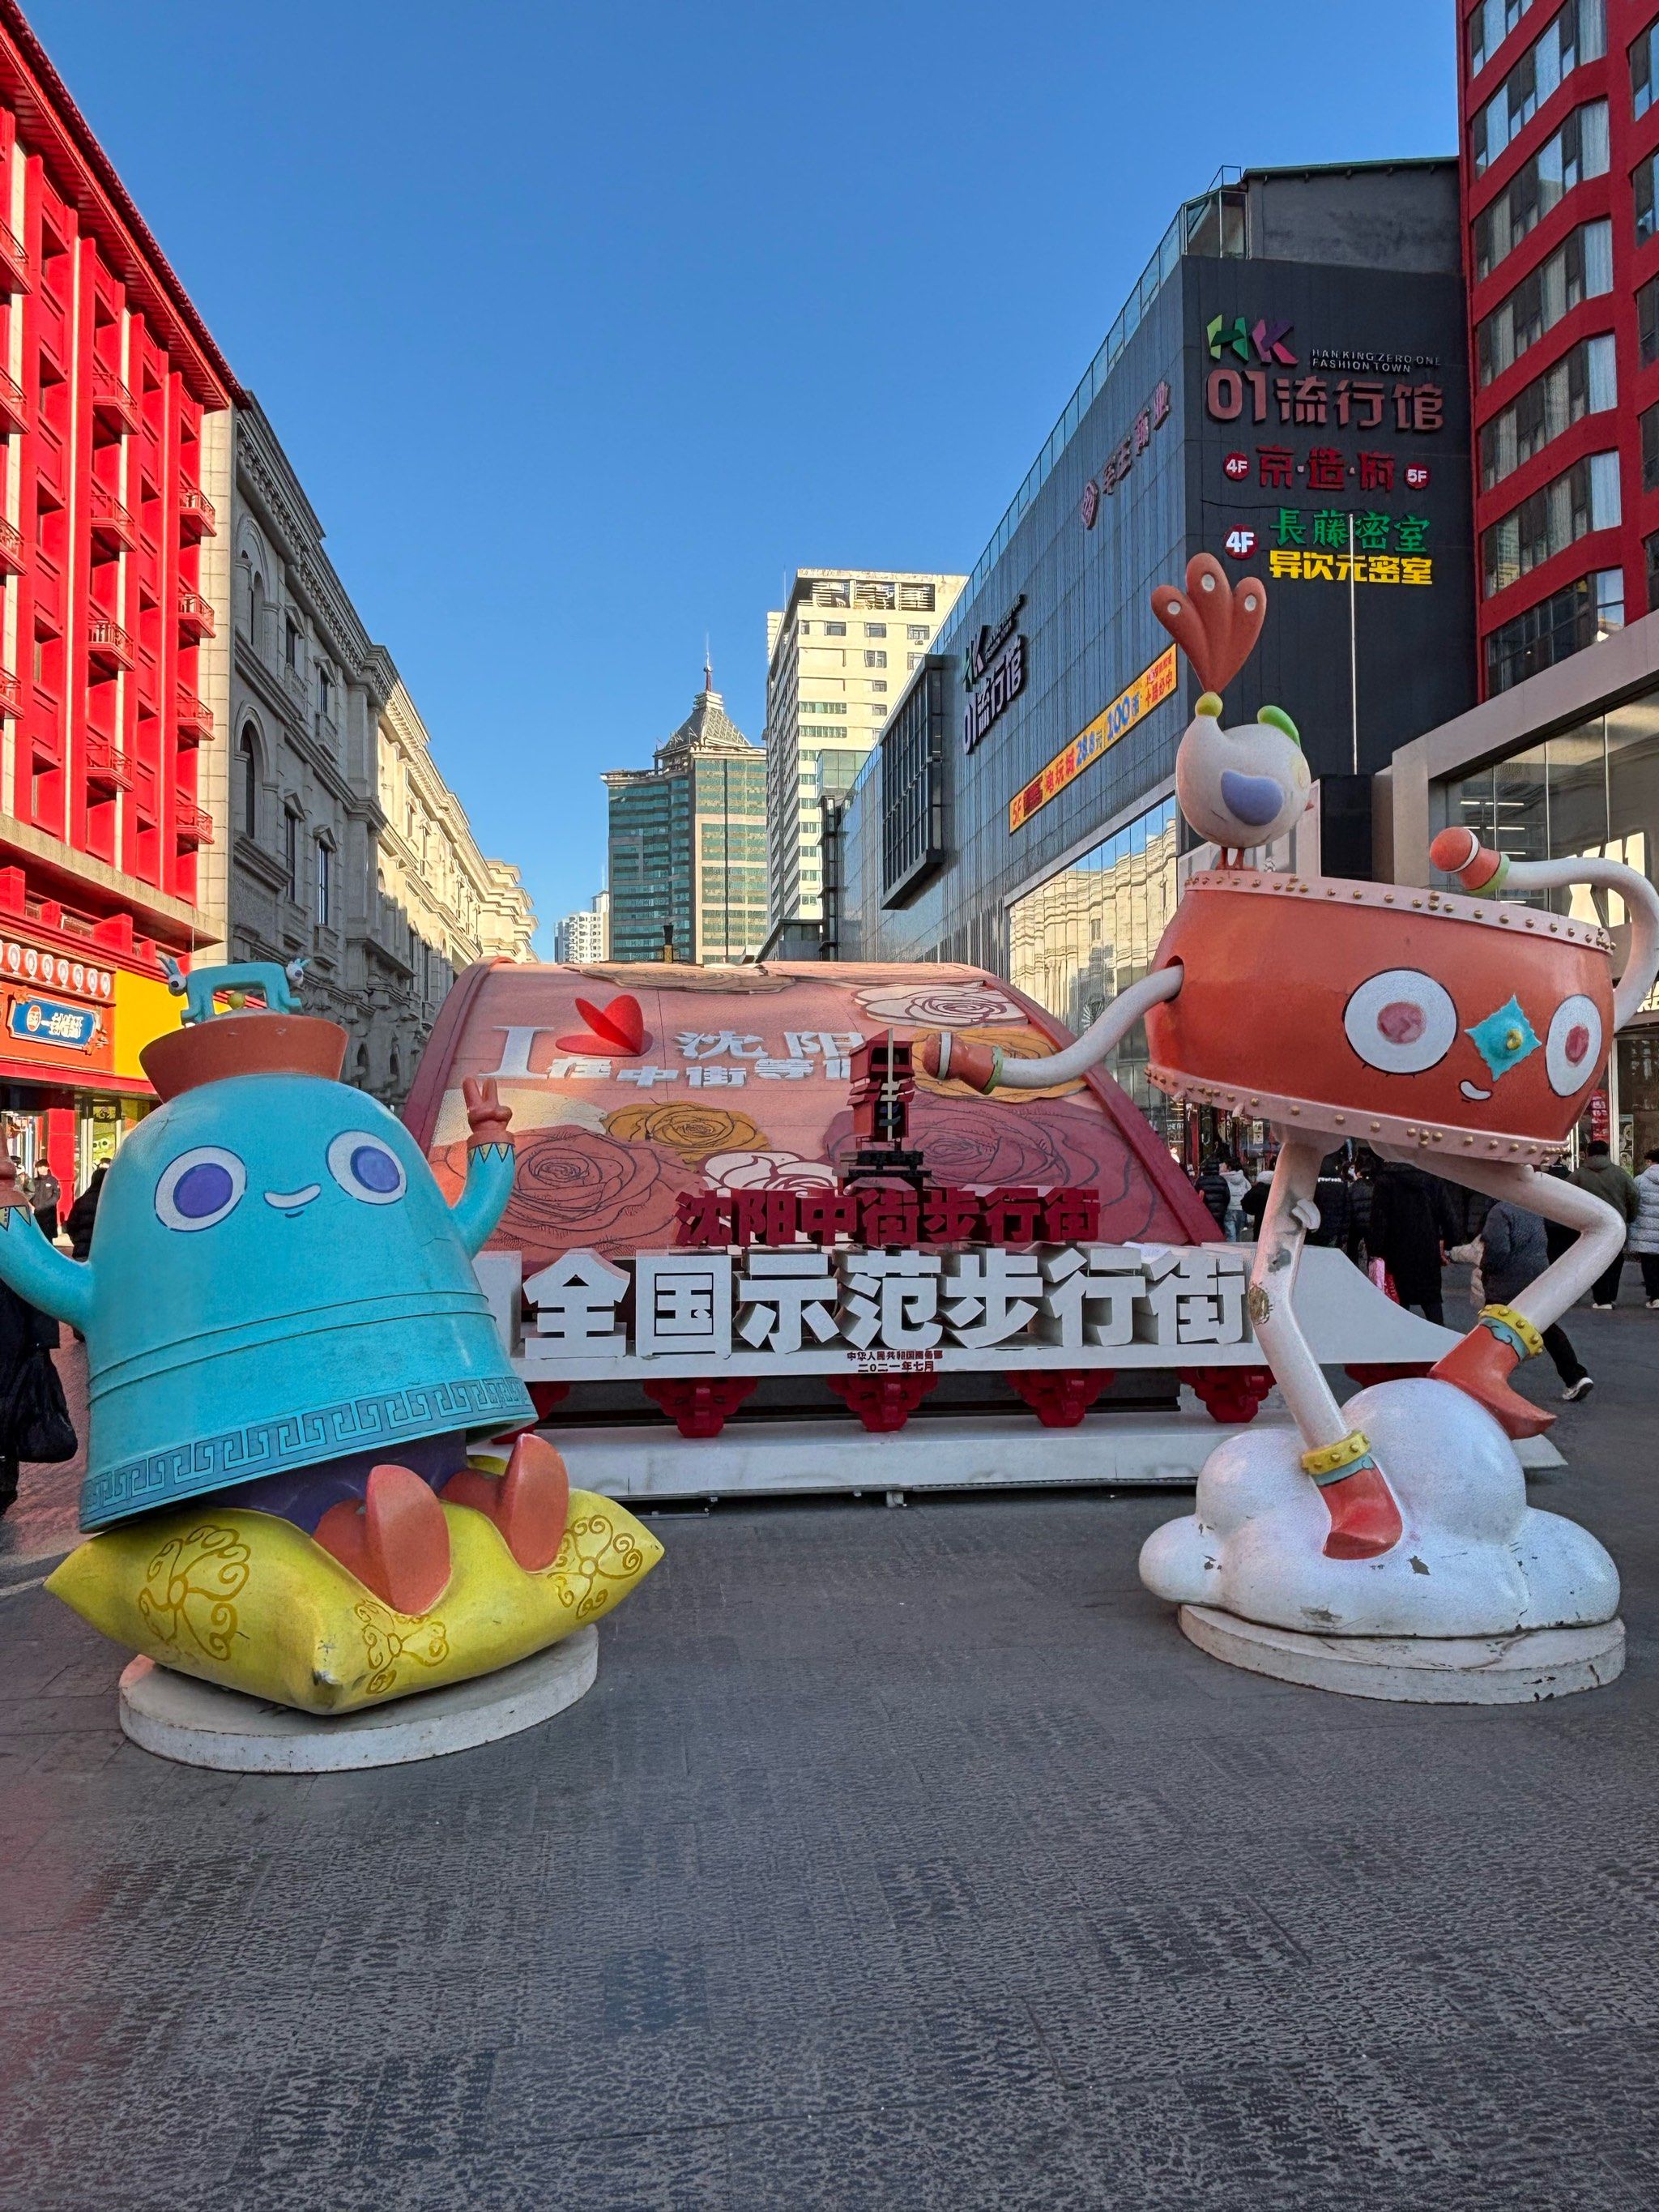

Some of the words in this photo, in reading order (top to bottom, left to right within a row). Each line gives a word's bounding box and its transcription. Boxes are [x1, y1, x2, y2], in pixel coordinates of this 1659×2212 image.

[1312, 358, 1370, 370] FASHION
[1373, 361, 1410, 373] TOWN
[1379, 352, 1412, 363] ZERO
[1206, 369, 1444, 431] 01流行馆
[1226, 458, 1248, 473] 4F
[1407, 468, 1427, 483] 5F
[1225, 532, 1255, 553] 4F
[1269, 549, 1433, 585] 异次元密室
[671, 1030, 866, 1060] 沈阳
[675, 1186, 1100, 1246] 沈阳中街步行街
[522, 1248, 1247, 1359] 全国示范步行街
[847, 1349, 943, 1361] 中华人民共和国商务部
